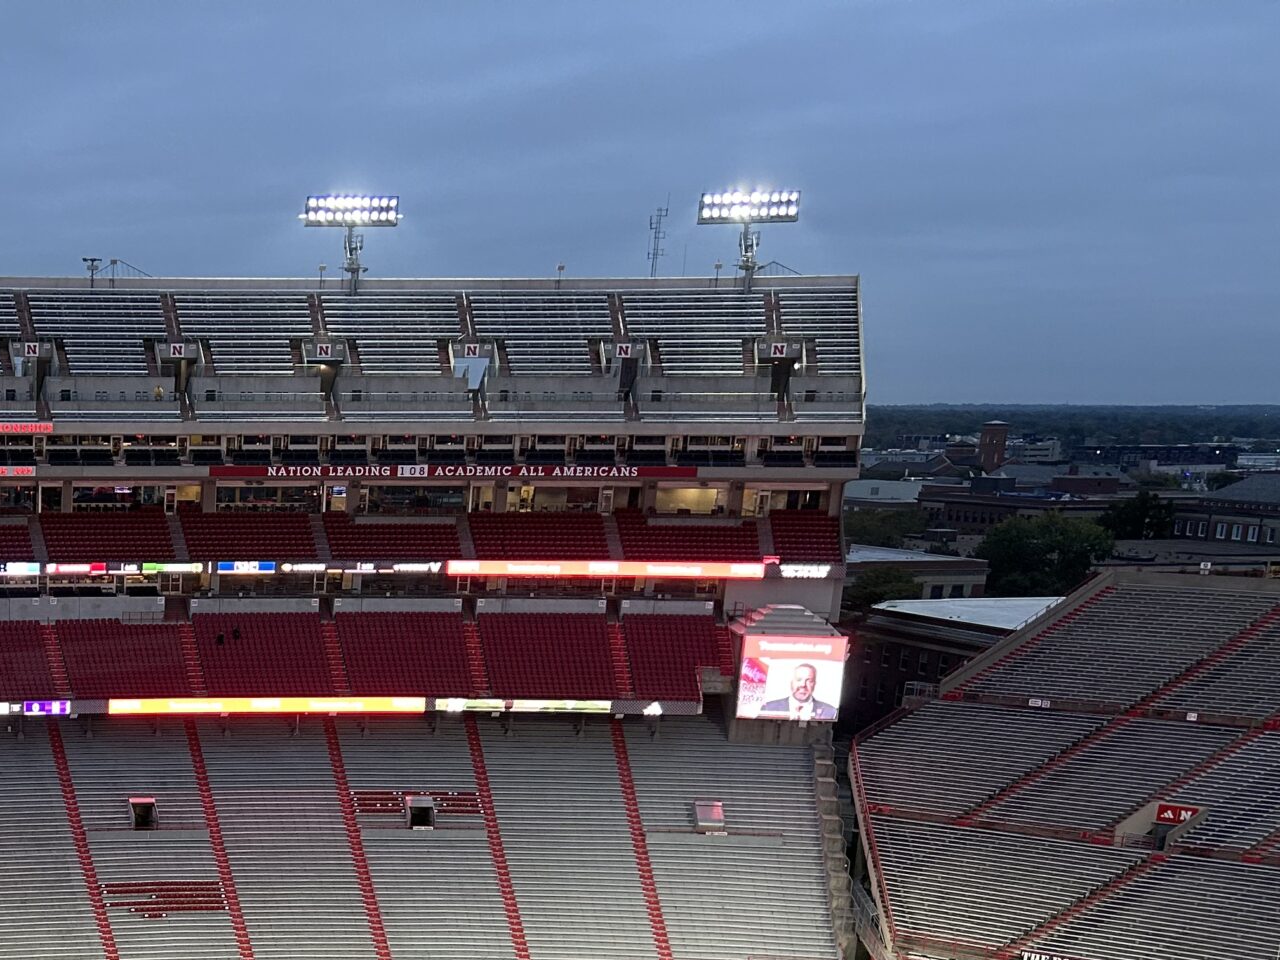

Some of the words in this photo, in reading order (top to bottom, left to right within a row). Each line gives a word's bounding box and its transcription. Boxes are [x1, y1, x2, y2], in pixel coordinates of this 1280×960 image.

[26, 344, 38, 355] N
[172, 345, 183, 355] N
[318, 345, 330, 356] N
[466, 346, 478, 356] N
[618, 345, 630, 356] N
[772, 344, 786, 355] N
[267, 467, 321, 476] NATION
[329, 467, 390, 476] LEADING
[399, 466, 426, 476] 108
[435, 467, 512, 477] ACADEMIC
[519, 467, 545, 477] ALL
[552, 467, 638, 477] AMERICANS
[1180, 810, 1192, 821] N
